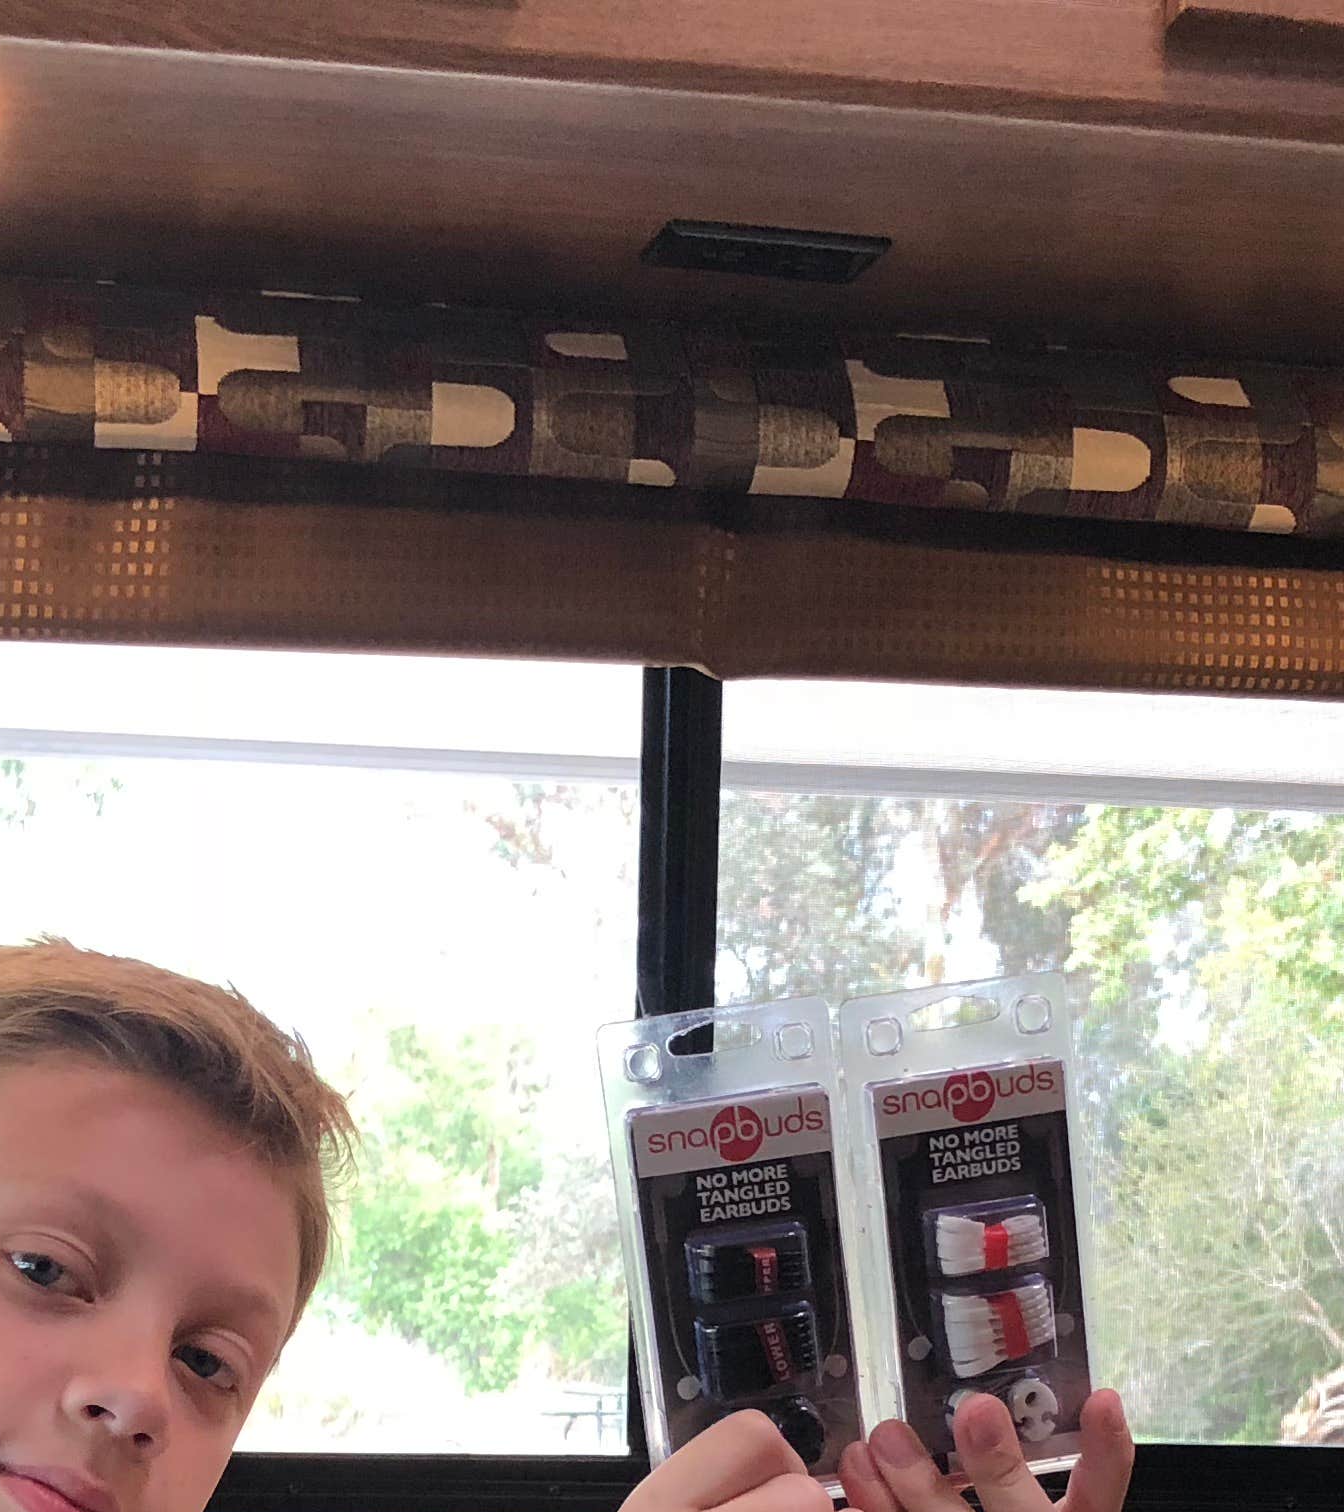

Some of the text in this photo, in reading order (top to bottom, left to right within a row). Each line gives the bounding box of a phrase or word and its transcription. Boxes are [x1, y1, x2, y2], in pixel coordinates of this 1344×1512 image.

[883, 1064, 1053, 1119] snapbuds
[648, 1096, 823, 1157] snapbuds
[929, 1124, 1019, 1151] NO MORE
[929, 1142, 1020, 1167] TANGLED
[696, 1164, 787, 1191] NO MORE
[933, 1157, 1021, 1183] EARBUDS
[697, 1180, 790, 1206] TANGLED
[700, 1197, 791, 1223] EARBUDS
[761, 1257, 773, 1292] PPER
[763, 1322, 792, 1382] LOWER
